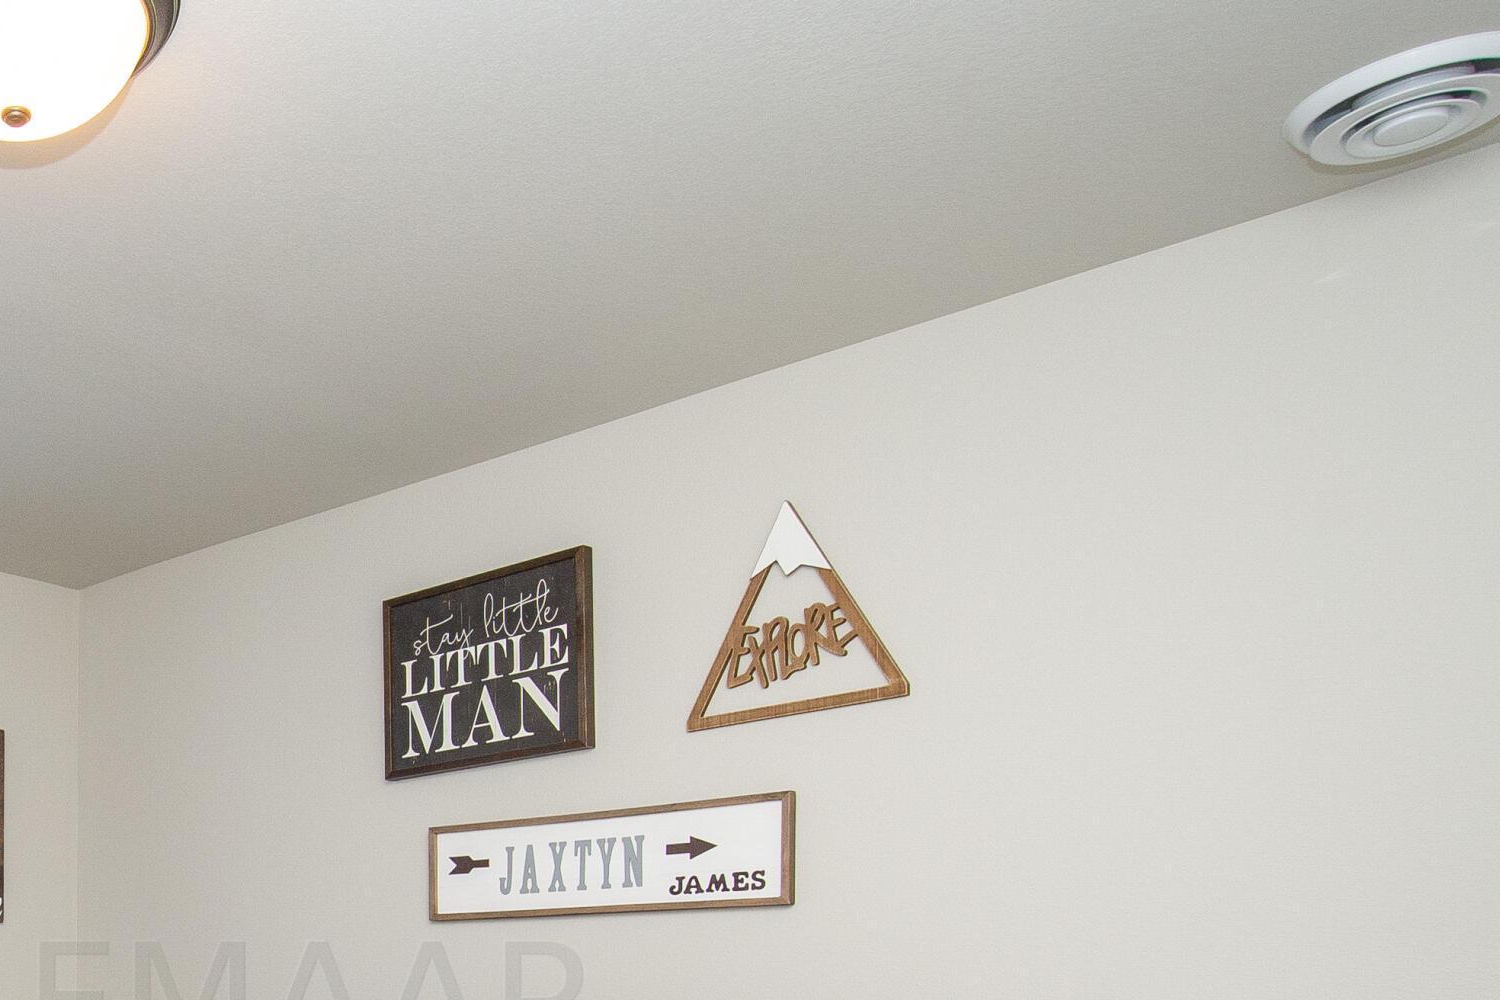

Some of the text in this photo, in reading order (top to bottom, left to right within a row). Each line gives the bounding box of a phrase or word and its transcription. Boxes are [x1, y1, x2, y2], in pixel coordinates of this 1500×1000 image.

[412, 578, 559, 661] stay little
[400, 623, 570, 699] LITTLE
[400, 667, 570, 760] MAN
[499, 834, 645, 896] JAXTYN
[668, 869, 767, 896] JAMES
